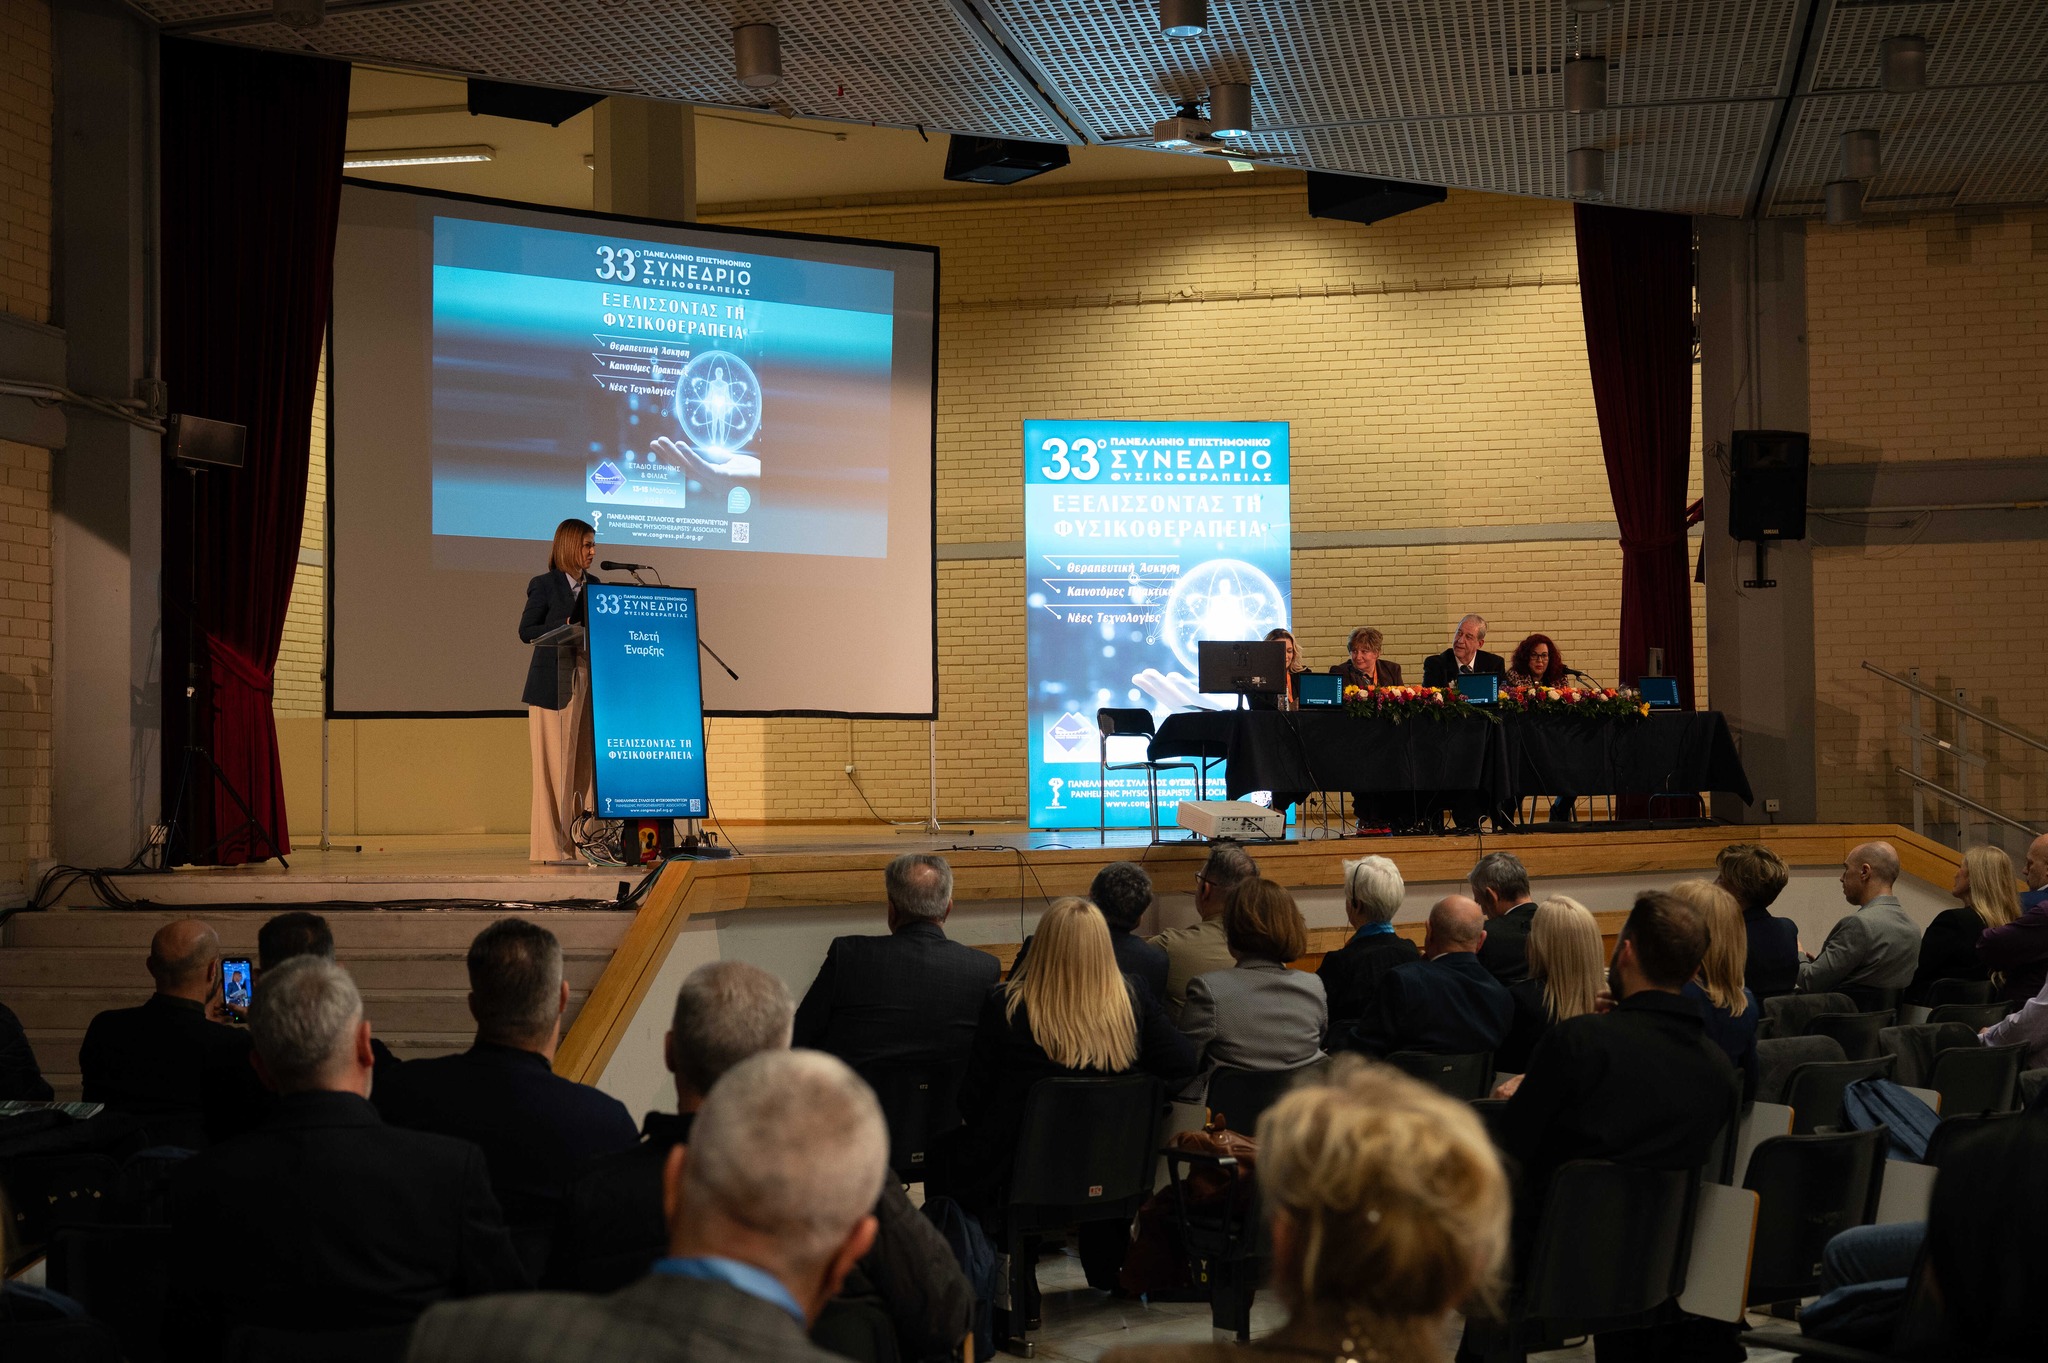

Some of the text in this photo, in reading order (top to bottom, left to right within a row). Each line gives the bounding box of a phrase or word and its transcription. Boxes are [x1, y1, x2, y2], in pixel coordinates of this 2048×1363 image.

[644, 250, 751, 268] ΠΑΝΕΛΛΗΝΙΟ ΕΠΙΣΤΗΜΟΝΙΚΟ
[643, 260, 750, 285] ΣΥΝΕΔΡΙΟ
[643, 278, 750, 296] ΦΥΣΙΚΟΘΕΡΑΠΕΙΑΣ
[603, 292, 744, 320] ΕΞΕΛΙΣΣΟΝΤΑΣ ΤΗ
[603, 313, 743, 339] ΦΥΣΙΚΟΘΕΡΑΠΕΙΑ
[610, 342, 690, 358] Θεραπευτική Άσκηση
[609, 361, 650, 374] Καινοτόμες
[609, 382, 675, 397] Νέες Τεχνολογίες
[1110, 437, 1271, 447] ΠΑΝΕΛΛΗΝΙΟ ΕΠΙΣΤΗΜΟΝΙΚΟ
[1111, 450, 1272, 469] ΣΥΝΕΔΡΙΟ
[1111, 472, 1272, 482] ΦΥΣΙΚΟΘΕΡΑΠΕΙΑΣ
[1053, 495, 1261, 513] ΕΞΕΛΙΣΣΟΝΤΑΣ ΤΗ
[1054, 520, 1261, 538] ΦΥΣΙΚΟΘΕΡΑΠΕΙΑ
[632, 532, 703, 541] www.congress.psf.org.gr
[1067, 562, 1180, 574] Θεραπευτική Άσκηση
[1067, 586, 1125, 598] Καινοτόμες
[624, 600, 687, 612] ΣΥΝΕΔΡΙΟ
[1067, 612, 1161, 624] Νέες Τεχνολογίες
[629, 630, 659, 643] Τελετή
[624, 644, 664, 657] Έναρξης
[607, 739, 692, 748] ΕΞΕΛΙΣΣΟΝΤΑΣ ΤΗ
[608, 751, 692, 759] ΦΥΣΙΚΟΘΕΡΑΠΕΙΑ
